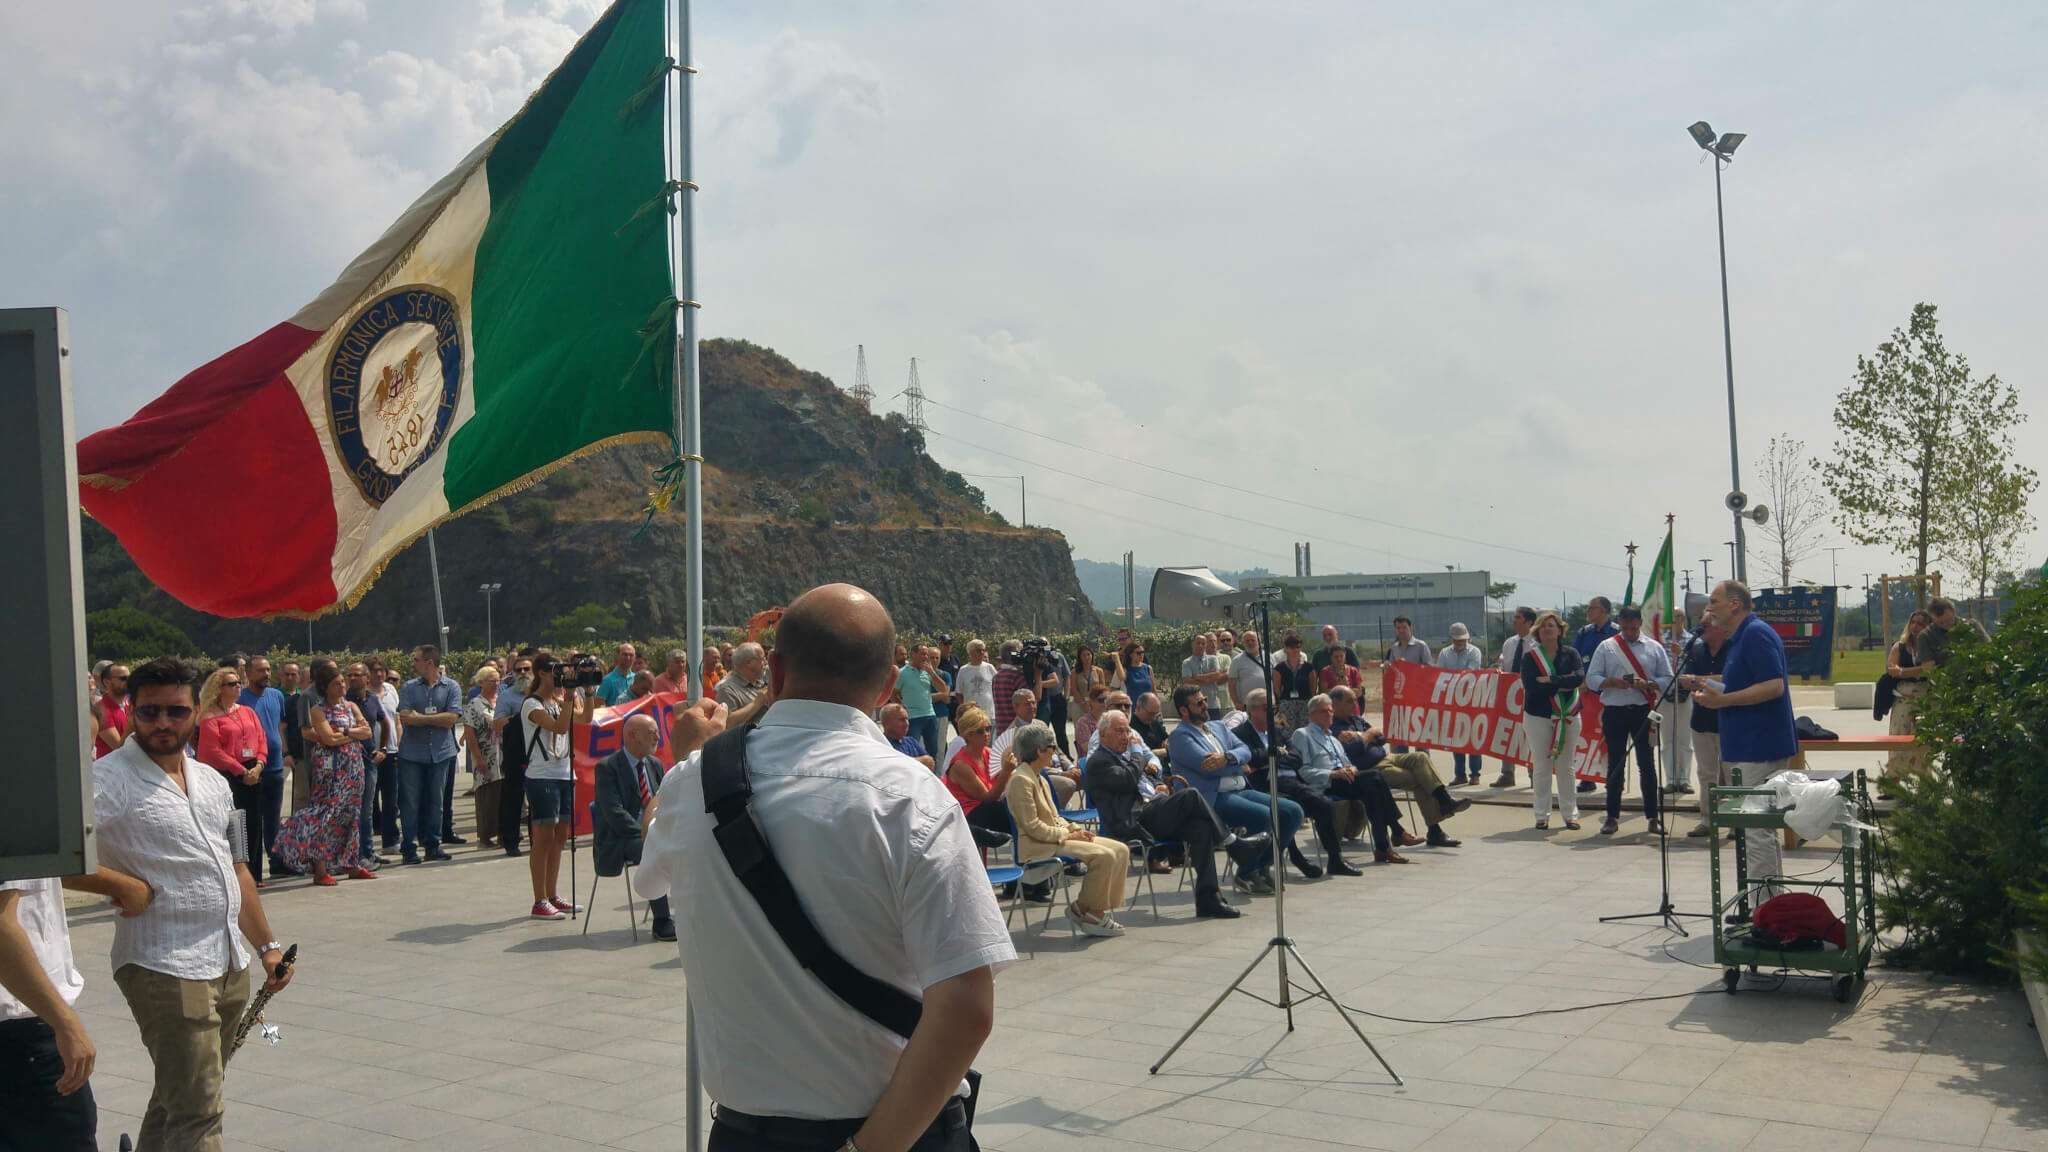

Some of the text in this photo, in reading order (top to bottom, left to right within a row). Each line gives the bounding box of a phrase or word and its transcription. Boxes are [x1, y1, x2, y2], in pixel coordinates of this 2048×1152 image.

[333, 301, 400, 436] FILARMONICA
[1430, 671, 1499, 709] FIOM
[1387, 704, 1609, 780] ANSALDO ENGIA
